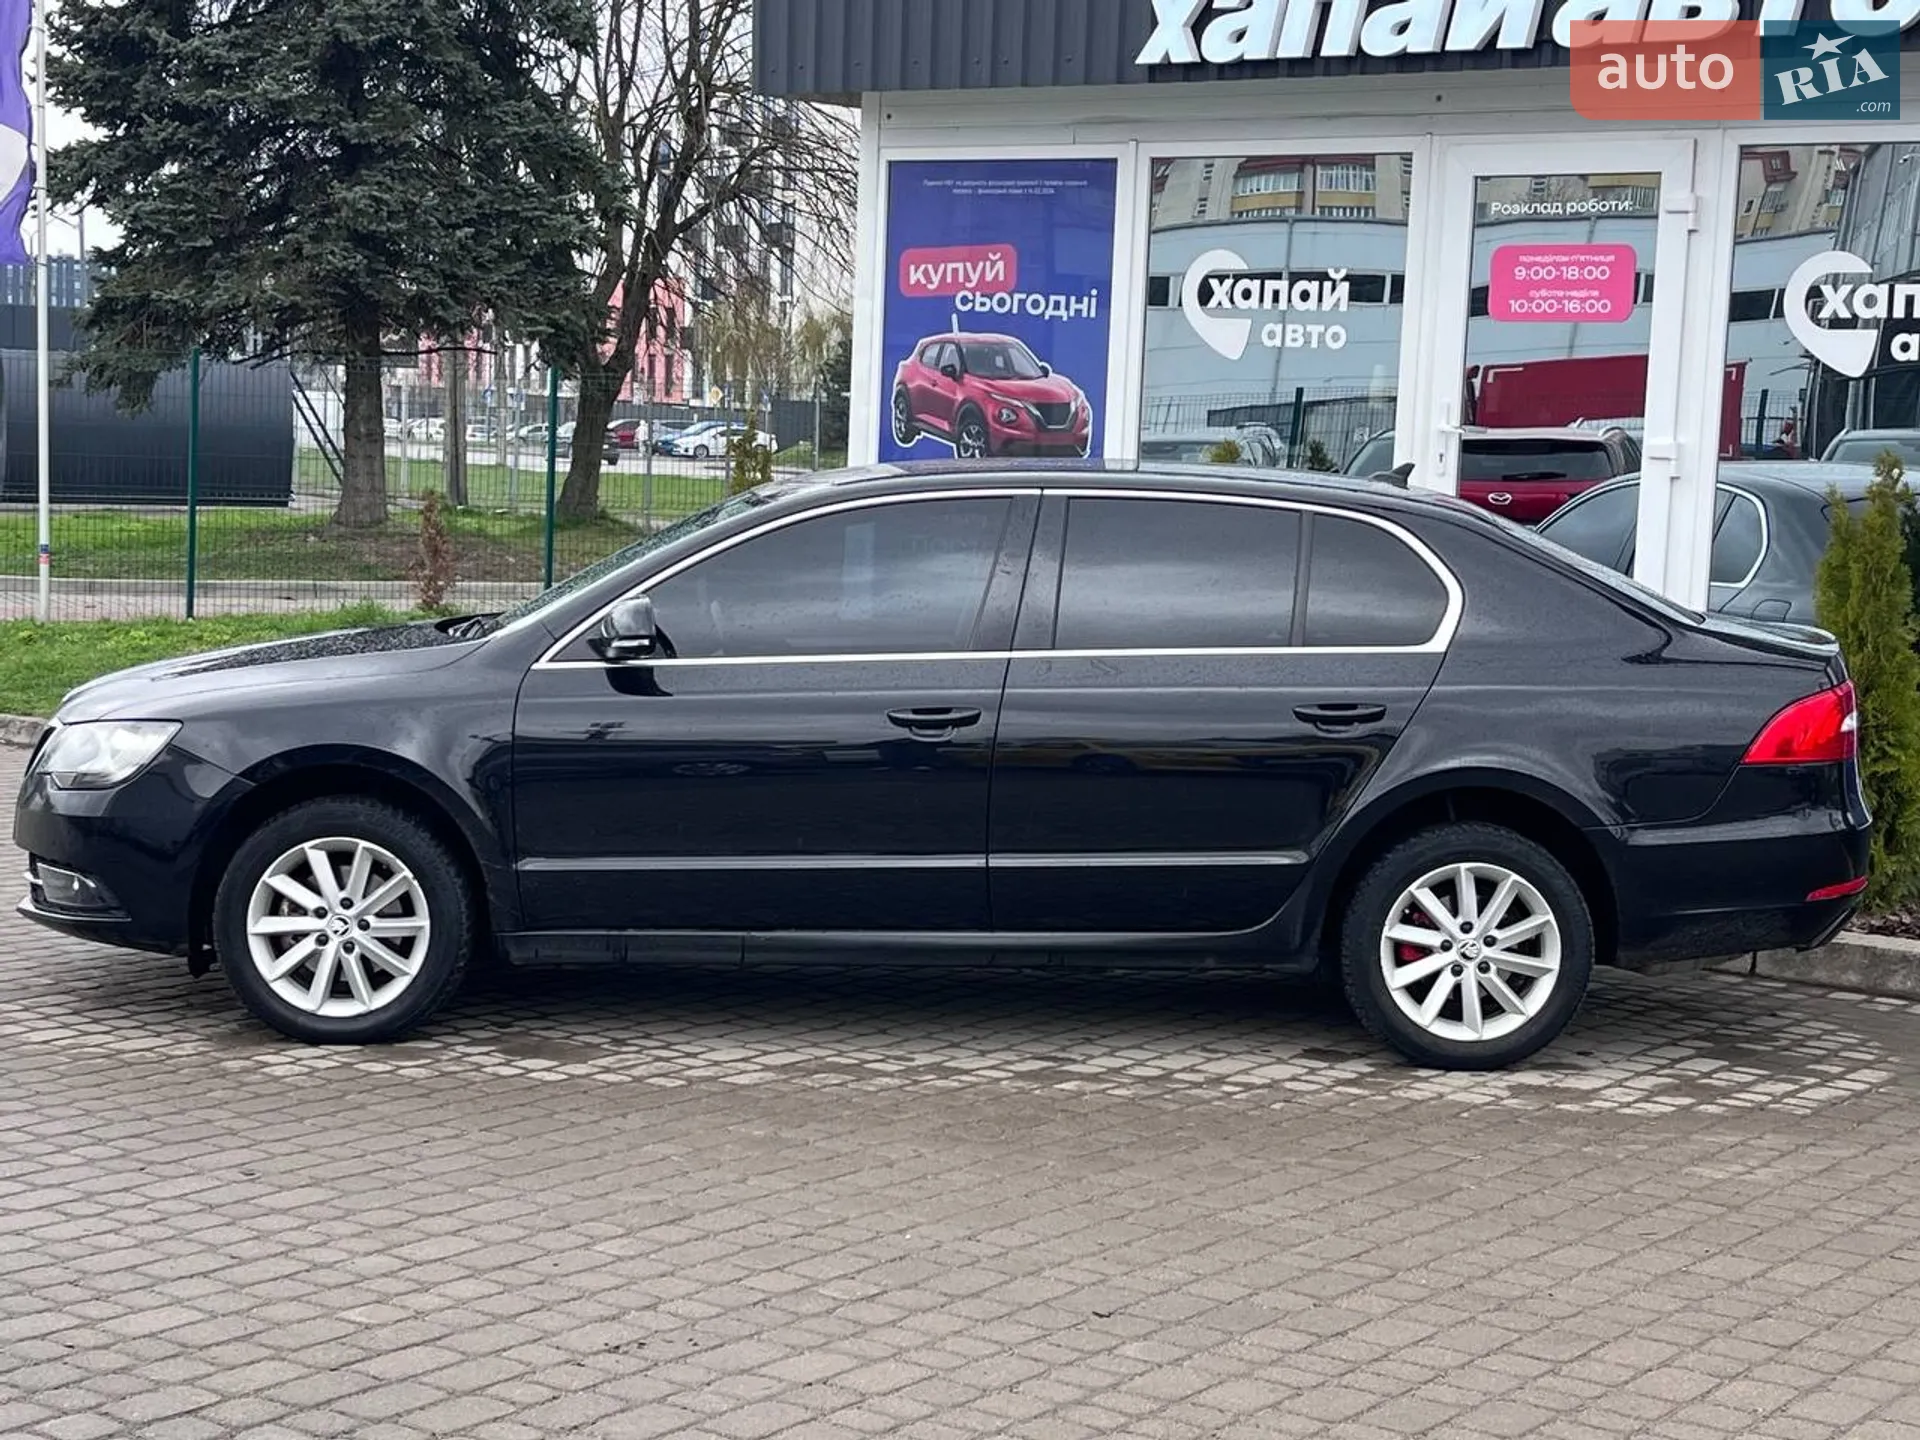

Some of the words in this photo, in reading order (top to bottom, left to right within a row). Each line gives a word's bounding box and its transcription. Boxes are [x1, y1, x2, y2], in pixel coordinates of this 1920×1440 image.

[1490, 202, 1563, 216] Розклад
[1565, 198, 1634, 217] роботи:
[909, 252, 1005, 290] купуй
[1513, 265, 1610, 281] 9:00-18:00
[1206, 268, 1350, 312] хапай
[954, 288, 1099, 322] сьогодні
[1508, 299, 1612, 314] 10:00-16:00
[1261, 322, 1348, 350] авто
[1890, 332, 1920, 362] а
